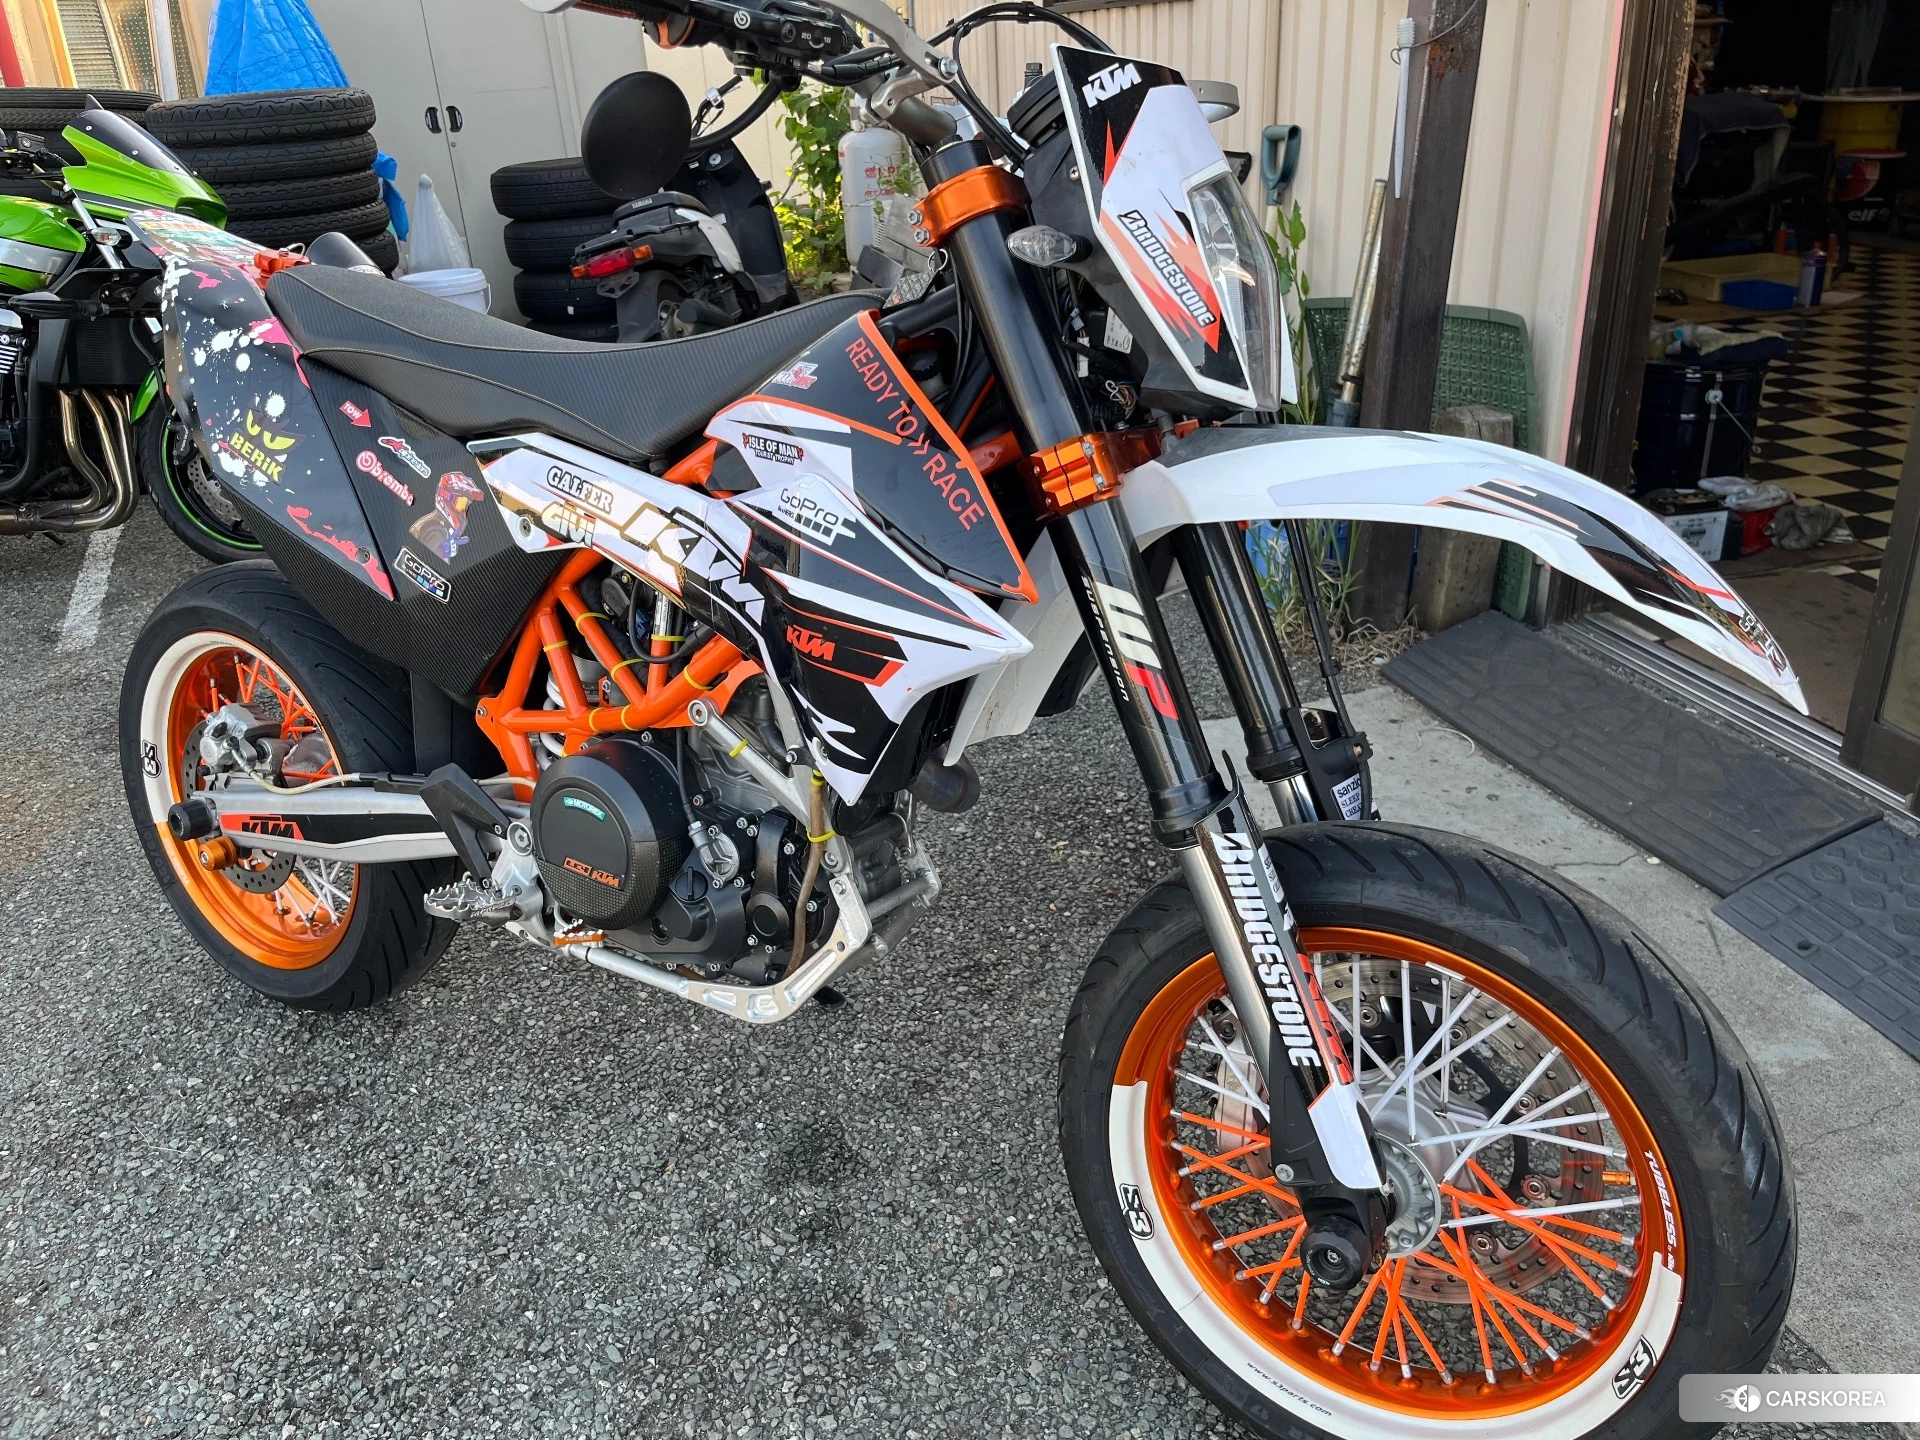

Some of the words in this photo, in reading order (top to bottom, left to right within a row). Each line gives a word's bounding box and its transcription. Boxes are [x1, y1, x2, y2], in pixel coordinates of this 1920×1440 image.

[1082, 62, 1142, 108] KTM
[1847, 208, 1879, 222] elf
[1117, 209, 1217, 328] BRIDGESTONE
[343, 402, 363, 419] TOW
[845, 337, 899, 403] READY
[922, 452, 985, 531] RACE
[748, 433, 766, 452] ISLE
[766, 438, 778, 453] OF
[778, 442, 799, 459] MAN
[370, 459, 414, 507] brembo
[547, 465, 614, 515] GALFER
[780, 488, 839, 527] GoPro
[786, 624, 836, 662] KTM
[1095, 581, 1180, 721] WP
[241, 815, 295, 839] KTM
[574, 798, 602, 818] MOTOREX
[592, 870, 620, 888] KTM
[1209, 831, 1322, 1067] BRIDGESTONE
[1119, 1183, 1155, 1240] S3
[1644, 1150, 1677, 1248] TUBELESS
[1246, 1362, 1332, 1416] www.s3parts.com
[1612, 1334, 1659, 1400] S3
